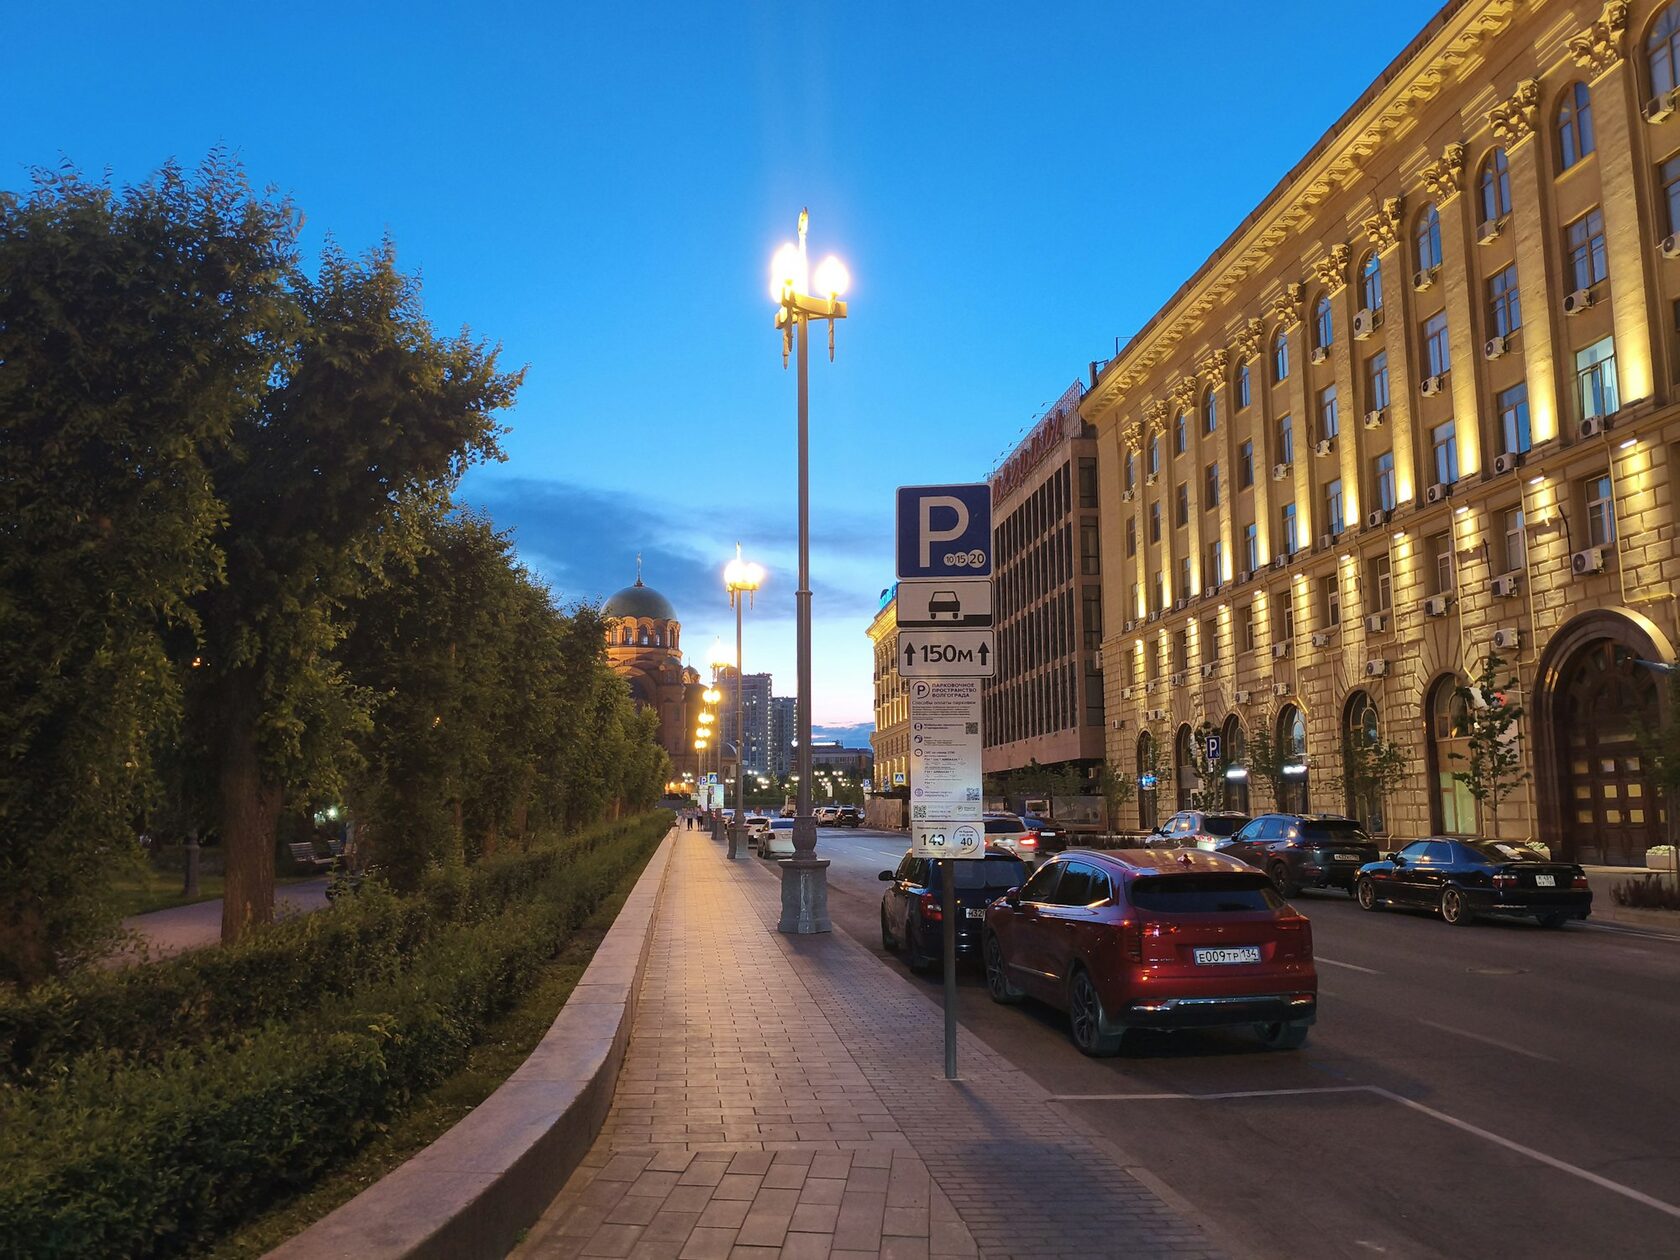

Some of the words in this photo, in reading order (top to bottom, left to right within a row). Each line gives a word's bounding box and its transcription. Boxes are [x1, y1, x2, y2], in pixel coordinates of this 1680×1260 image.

[919, 496, 969, 568] P
[945, 556, 955, 565] 10
[956, 554, 966, 565] 15
[969, 553, 984, 564] 20
[920, 644, 973, 663] 150м
[1209, 739, 1217, 757] P
[960, 837, 973, 846] 40
